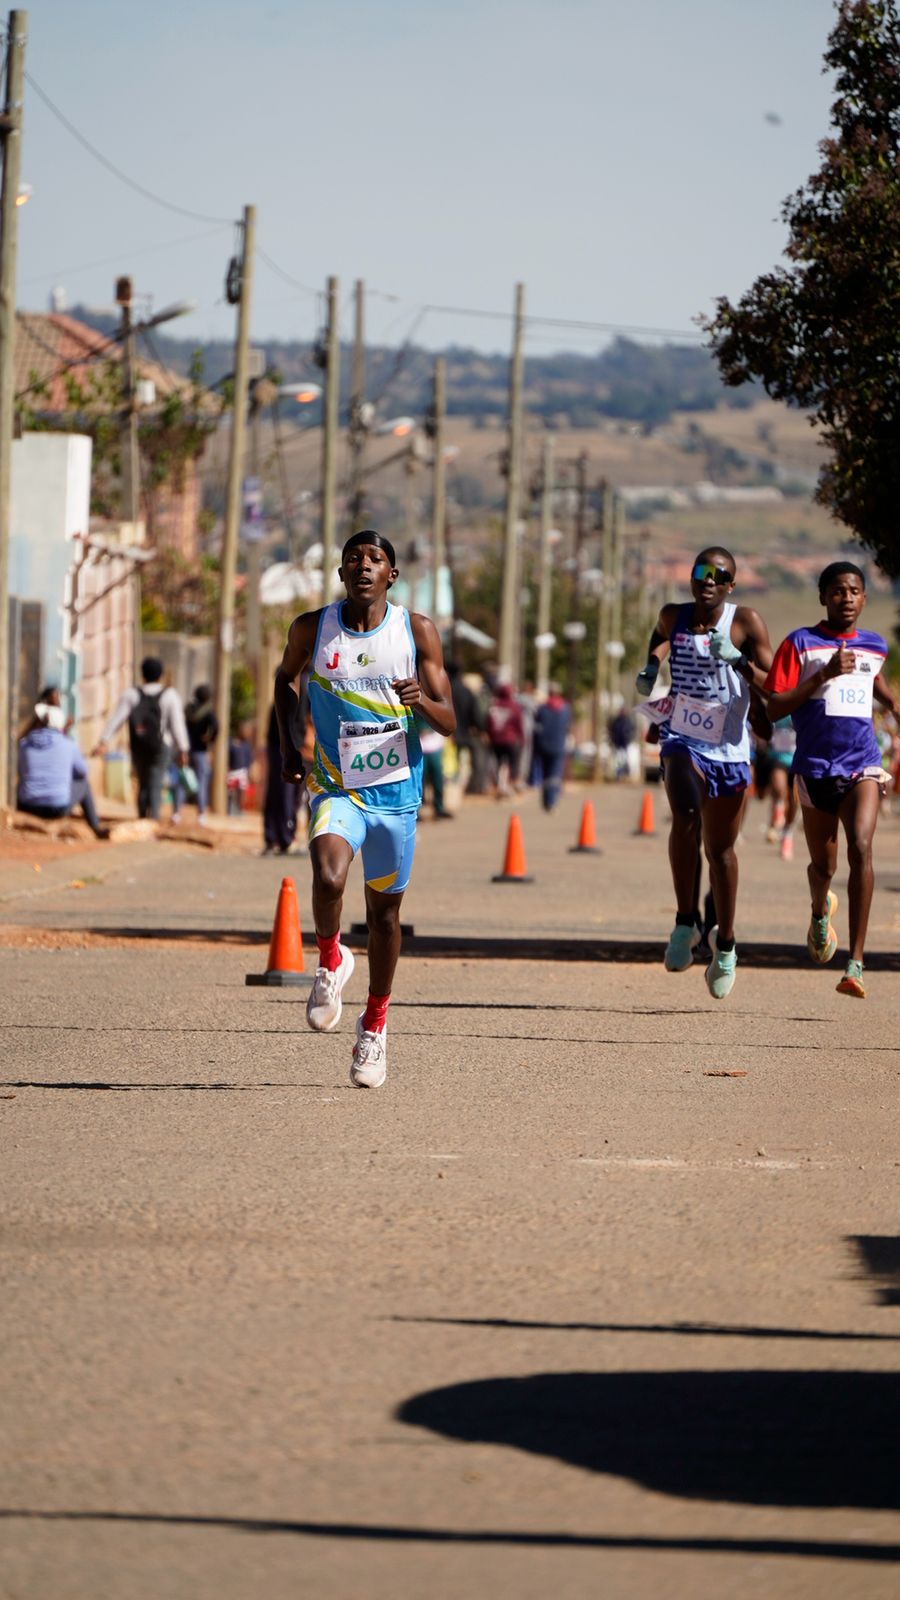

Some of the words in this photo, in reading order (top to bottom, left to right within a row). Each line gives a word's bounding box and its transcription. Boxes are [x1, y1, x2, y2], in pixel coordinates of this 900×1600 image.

[326, 653, 340, 670] J
[331, 675, 397, 693] FootPrin
[839, 688, 866, 704] 182
[682, 709, 714, 729] 106
[362, 726, 379, 736] 2026
[350, 748, 400, 772] 406
